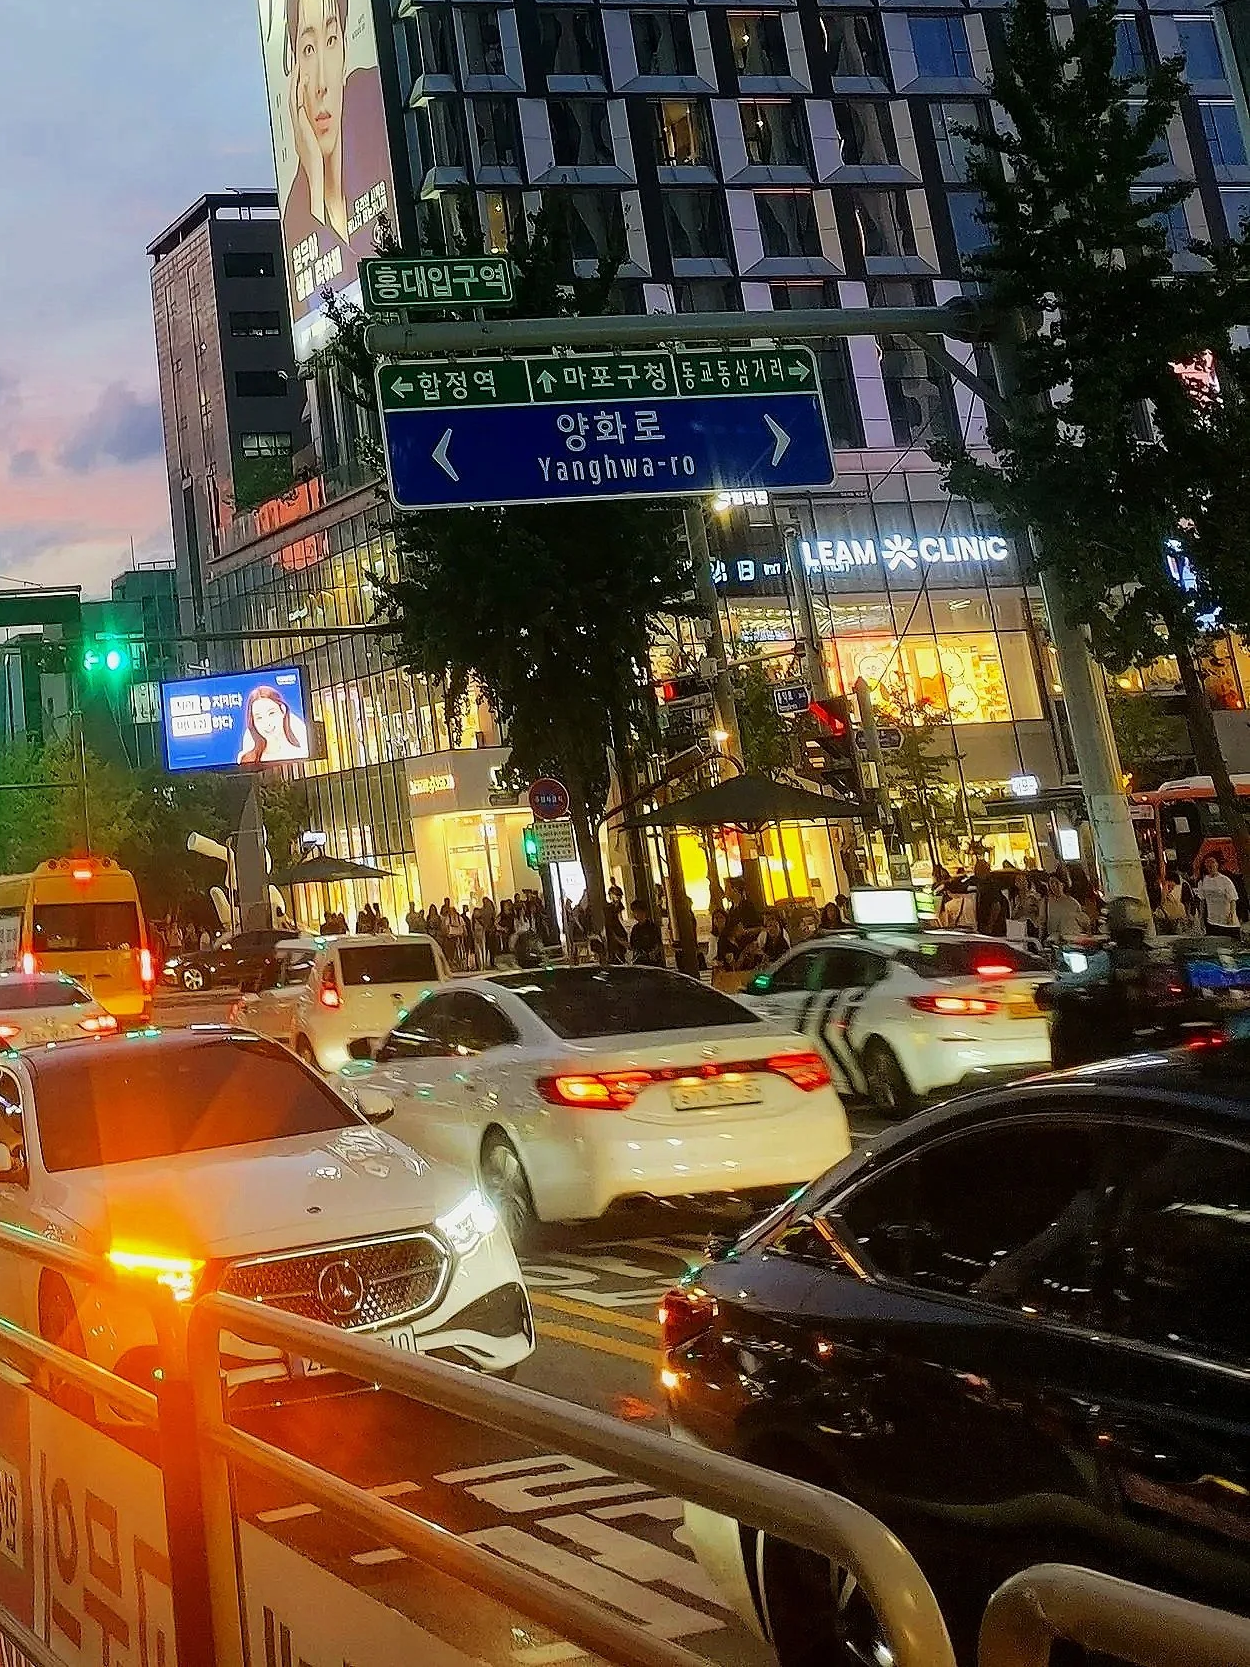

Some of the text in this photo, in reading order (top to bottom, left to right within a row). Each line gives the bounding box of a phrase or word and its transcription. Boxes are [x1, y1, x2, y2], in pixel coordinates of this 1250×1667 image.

[372, 260, 507, 304] 홍대입구역
[417, 369, 498, 401] 합정역
[563, 361, 667, 393] 마포구청
[681, 356, 786, 391] 동교동삼거리
[556, 409, 666, 453] 양화로
[538, 453, 696, 486] Yanghwa-ro
[803, 537, 878, 571] LEAM
[919, 534, 1009, 564] CLINIC
